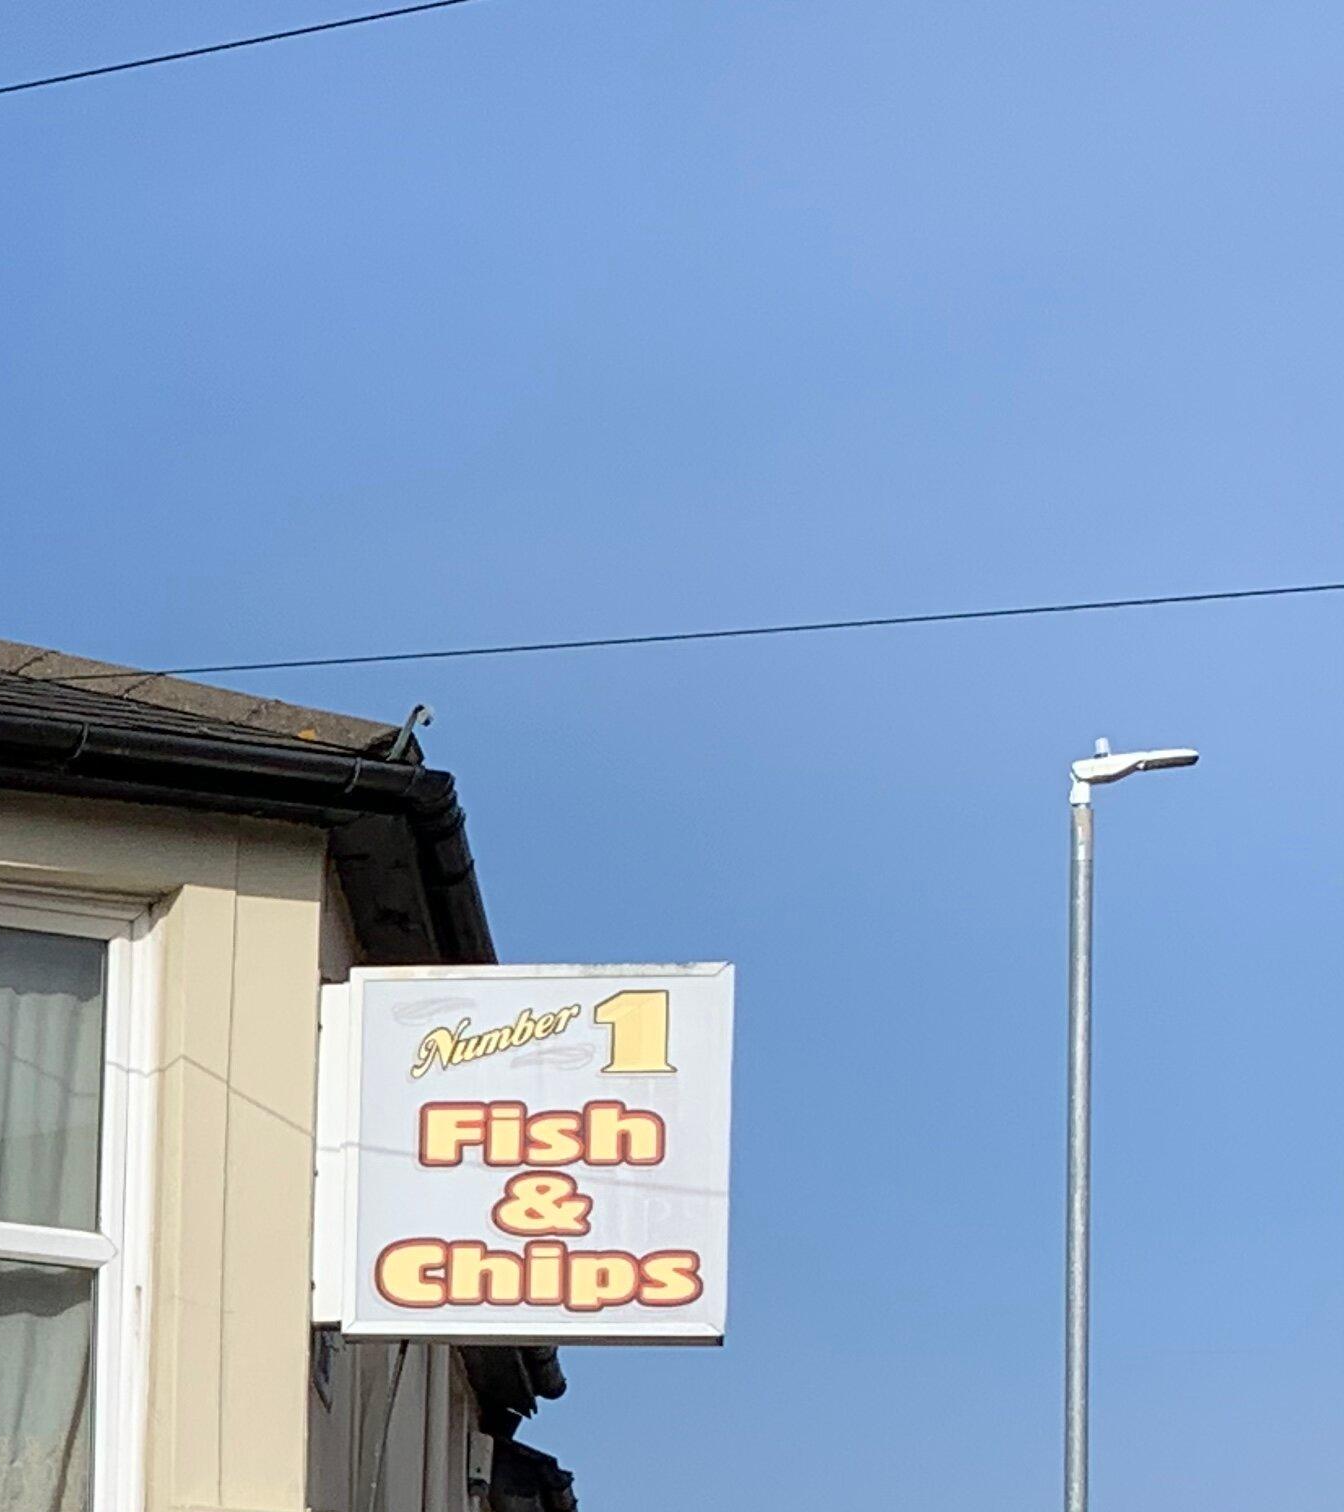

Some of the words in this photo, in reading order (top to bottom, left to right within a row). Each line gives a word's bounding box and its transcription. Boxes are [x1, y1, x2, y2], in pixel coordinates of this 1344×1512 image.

[410, 1003, 582, 1079] Number
[593, 989, 678, 1074] 1
[418, 1100, 666, 1167] Fish
[491, 1170, 594, 1236] &
[374, 1238, 704, 1312] Chips
